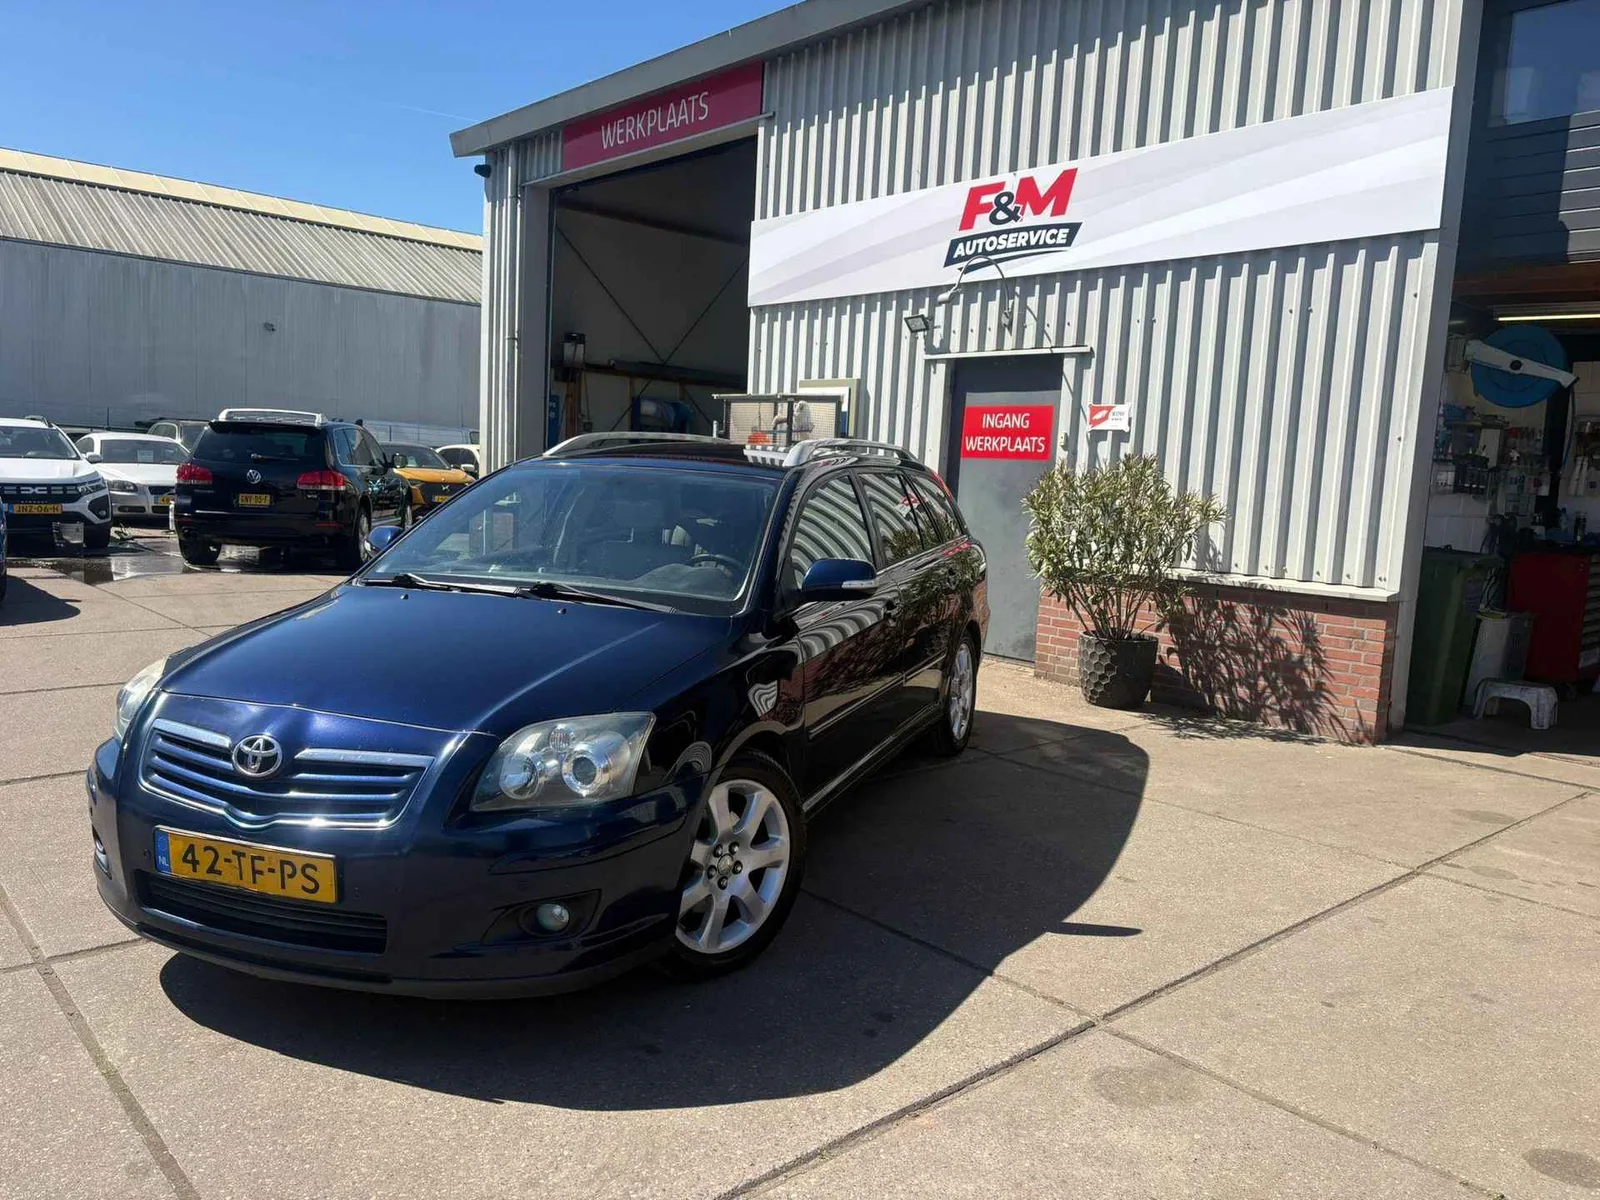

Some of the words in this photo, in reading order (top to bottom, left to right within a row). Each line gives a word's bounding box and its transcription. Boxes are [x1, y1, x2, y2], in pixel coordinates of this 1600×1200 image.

[601, 92, 709, 150] WERKPLAATS
[959, 167, 1078, 231] F&M
[953, 228, 1069, 259] AUTOSERVICE
[982, 413, 1030, 429] INGANG
[965, 436, 1046, 453] WERKPLAATS
[181, 843, 320, 895] 42-TF-PS
